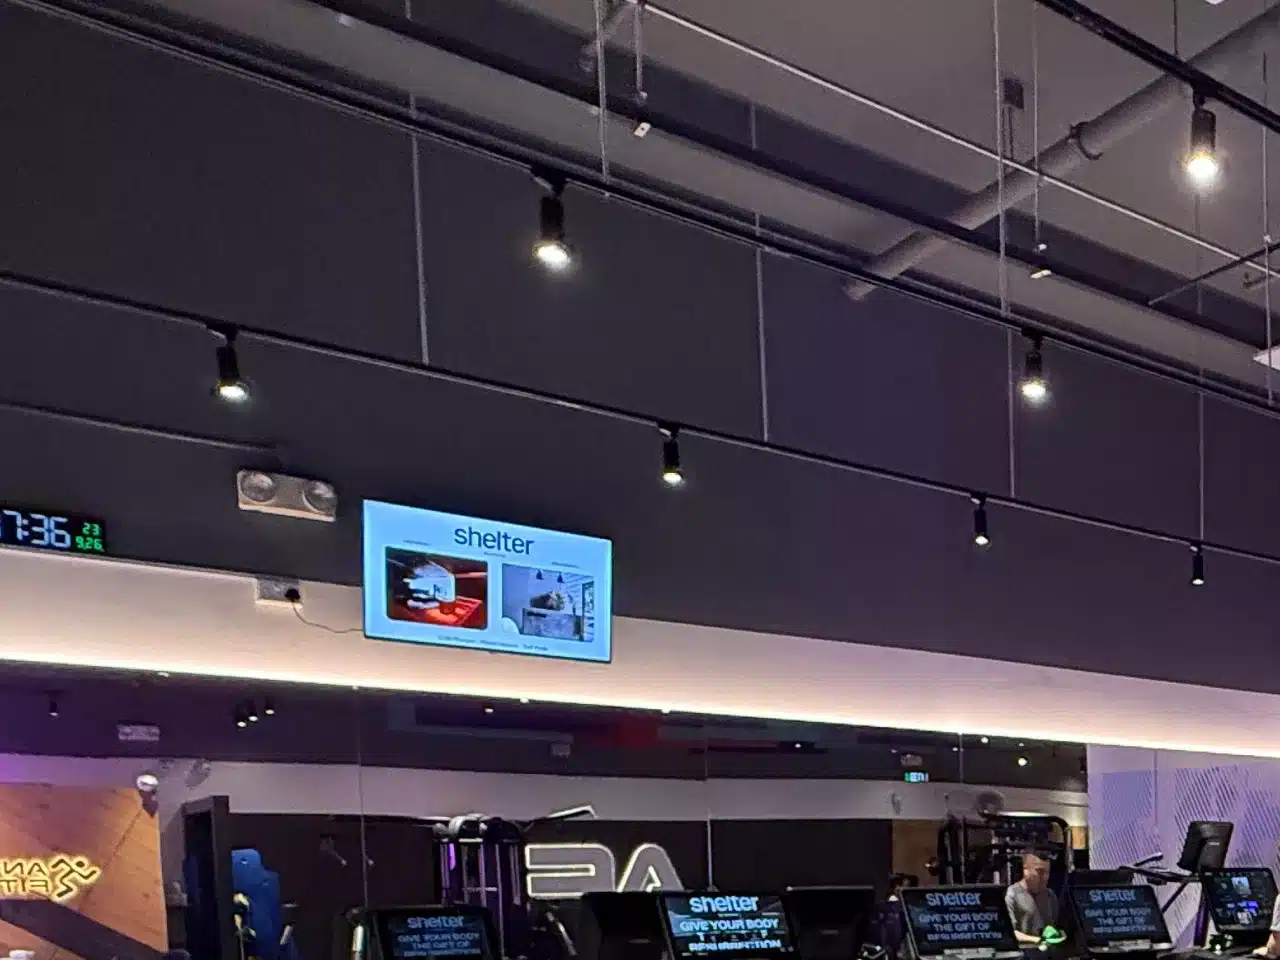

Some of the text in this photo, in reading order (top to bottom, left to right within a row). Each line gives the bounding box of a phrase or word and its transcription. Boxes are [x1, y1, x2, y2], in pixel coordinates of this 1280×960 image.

[0, 509, 71, 548] 7:36
[82, 522, 100, 536] 23
[454, 526, 535, 555] shelter
[688, 895, 759, 913] shelter
[925, 892, 981, 906] shelter
[407, 915, 464, 929] shelter
[943, 913, 971, 922] YOUR
[680, 918, 779, 932] GIVE YOUR BODY
